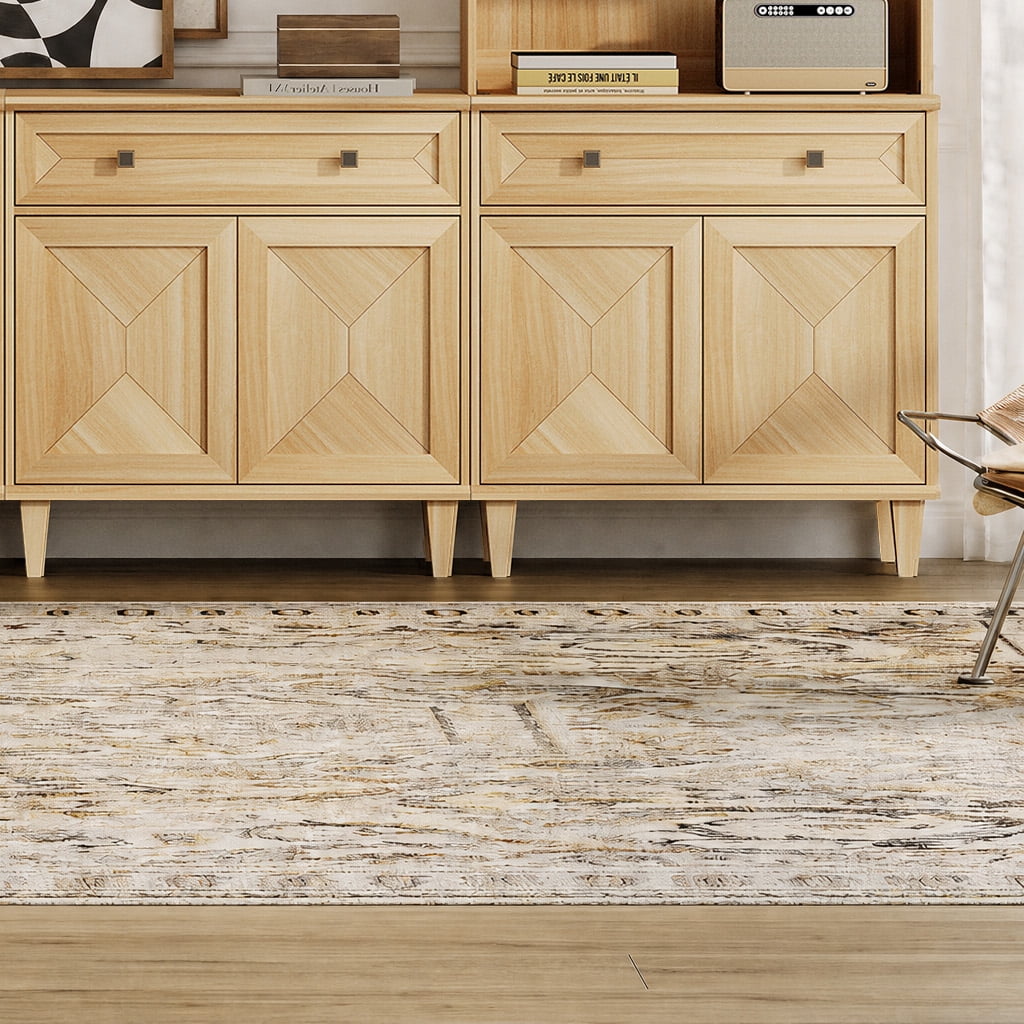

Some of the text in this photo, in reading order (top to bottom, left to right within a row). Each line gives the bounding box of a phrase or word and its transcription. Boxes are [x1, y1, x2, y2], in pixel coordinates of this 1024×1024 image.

[548, 73, 639, 84] IL ÉTAIT UNE FOIS LE CAFÉ
